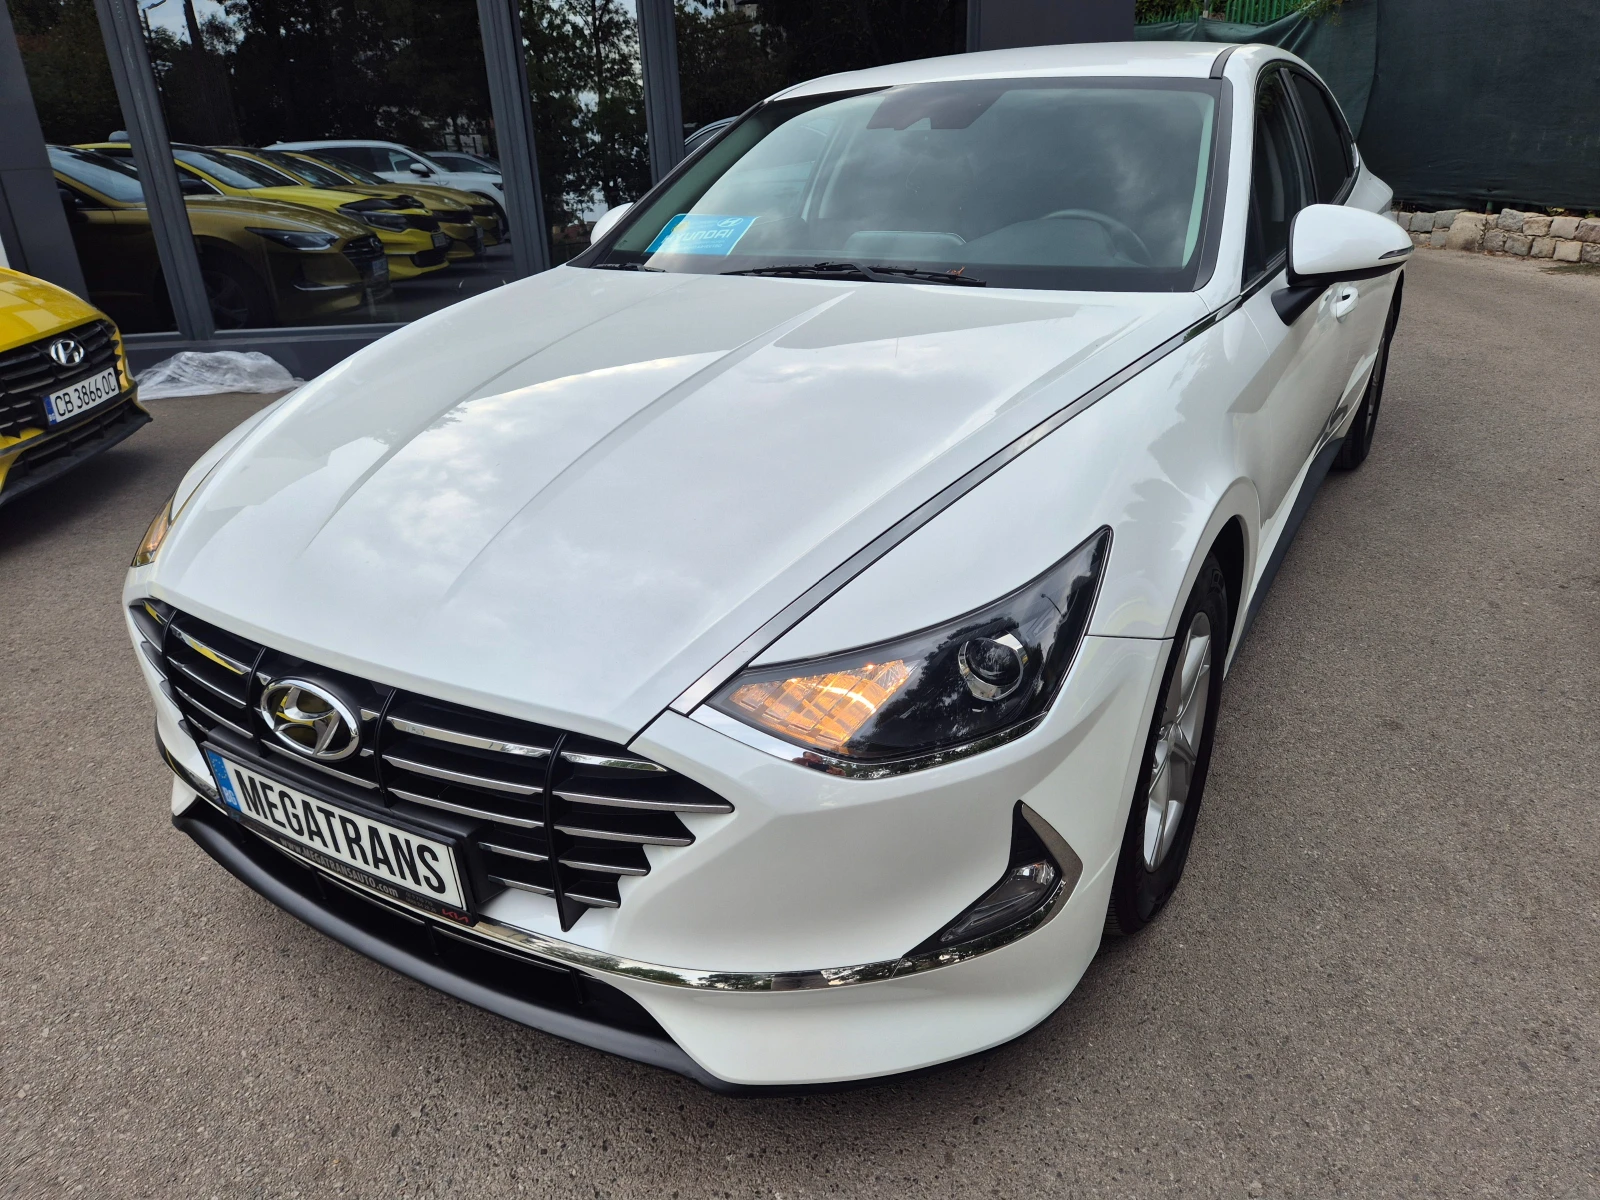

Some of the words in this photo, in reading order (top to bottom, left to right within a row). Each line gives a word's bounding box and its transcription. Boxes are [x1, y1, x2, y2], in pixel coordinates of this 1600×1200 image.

[54, 392, 74, 416] CB
[74, 379, 102, 409] 3866
[101, 372, 116, 395] OC
[222, 786, 238, 806] BG
[233, 768, 447, 895] MEGATRANS
